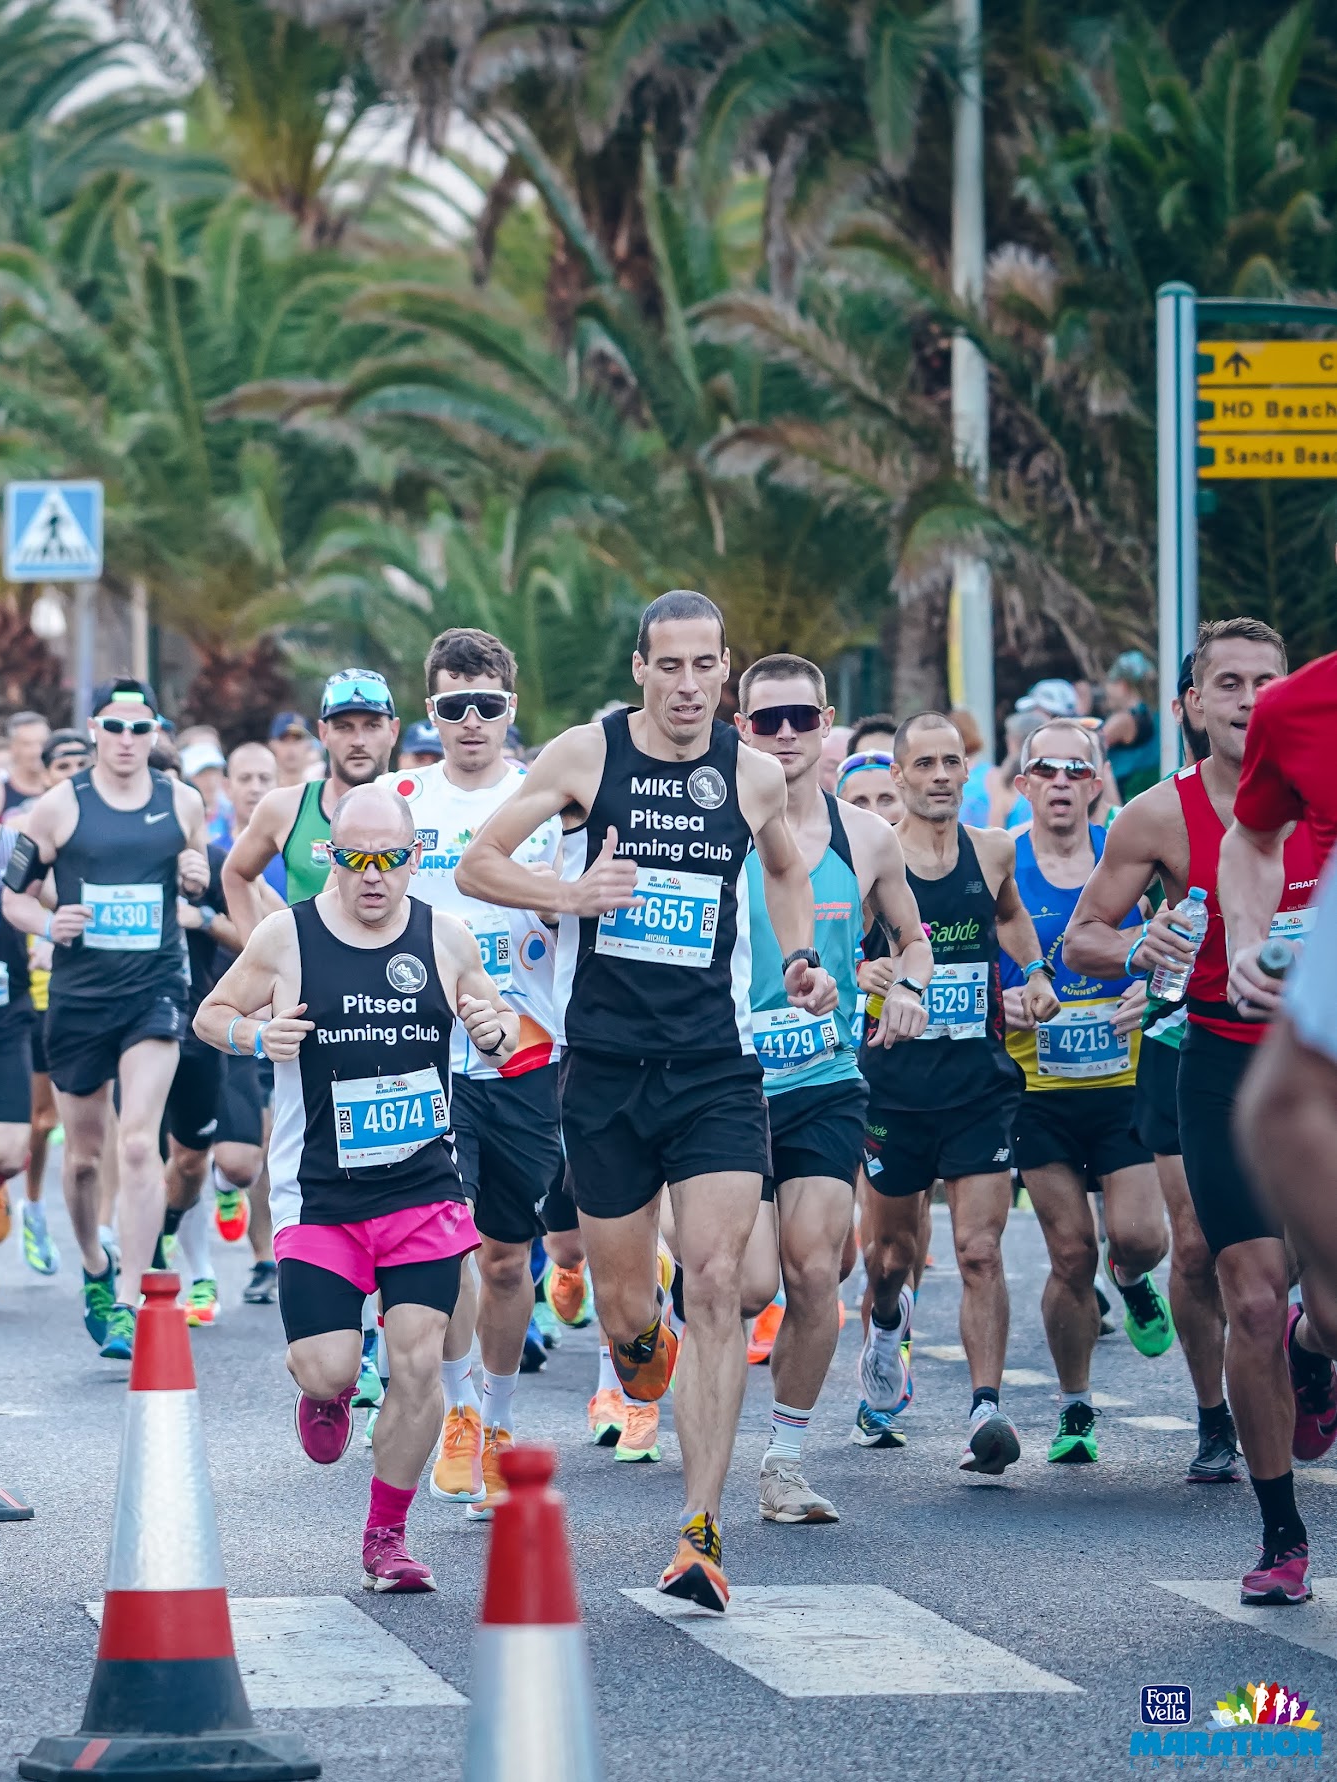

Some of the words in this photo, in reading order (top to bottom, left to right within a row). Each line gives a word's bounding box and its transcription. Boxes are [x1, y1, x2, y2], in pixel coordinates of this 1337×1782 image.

[1222, 402, 1254, 418] HD
[1266, 402, 1337, 418] Beach
[1225, 448, 1284, 465] Sands
[630, 777, 683, 798] MIKE
[630, 809, 705, 832] Pitsea
[416, 831, 436, 840] Font
[421, 840, 436, 849] ella
[688, 841, 733, 861] Club
[1289, 879, 1319, 891] CRAFT
[100, 904, 148, 927] 4330
[625, 895, 695, 932] 4655
[645, 933, 670, 944] MICHAEL
[929, 918, 979, 943] Saúde
[920, 986, 969, 1014] 4529
[1061, 984, 1103, 996] RUNNERS
[343, 994, 417, 1014] Pitsea
[317, 1025, 397, 1046] Running
[402, 1024, 440, 1042] Club
[760, 1028, 816, 1059] 4129
[1058, 1024, 1110, 1053] 4215
[363, 1098, 425, 1133] 4674
